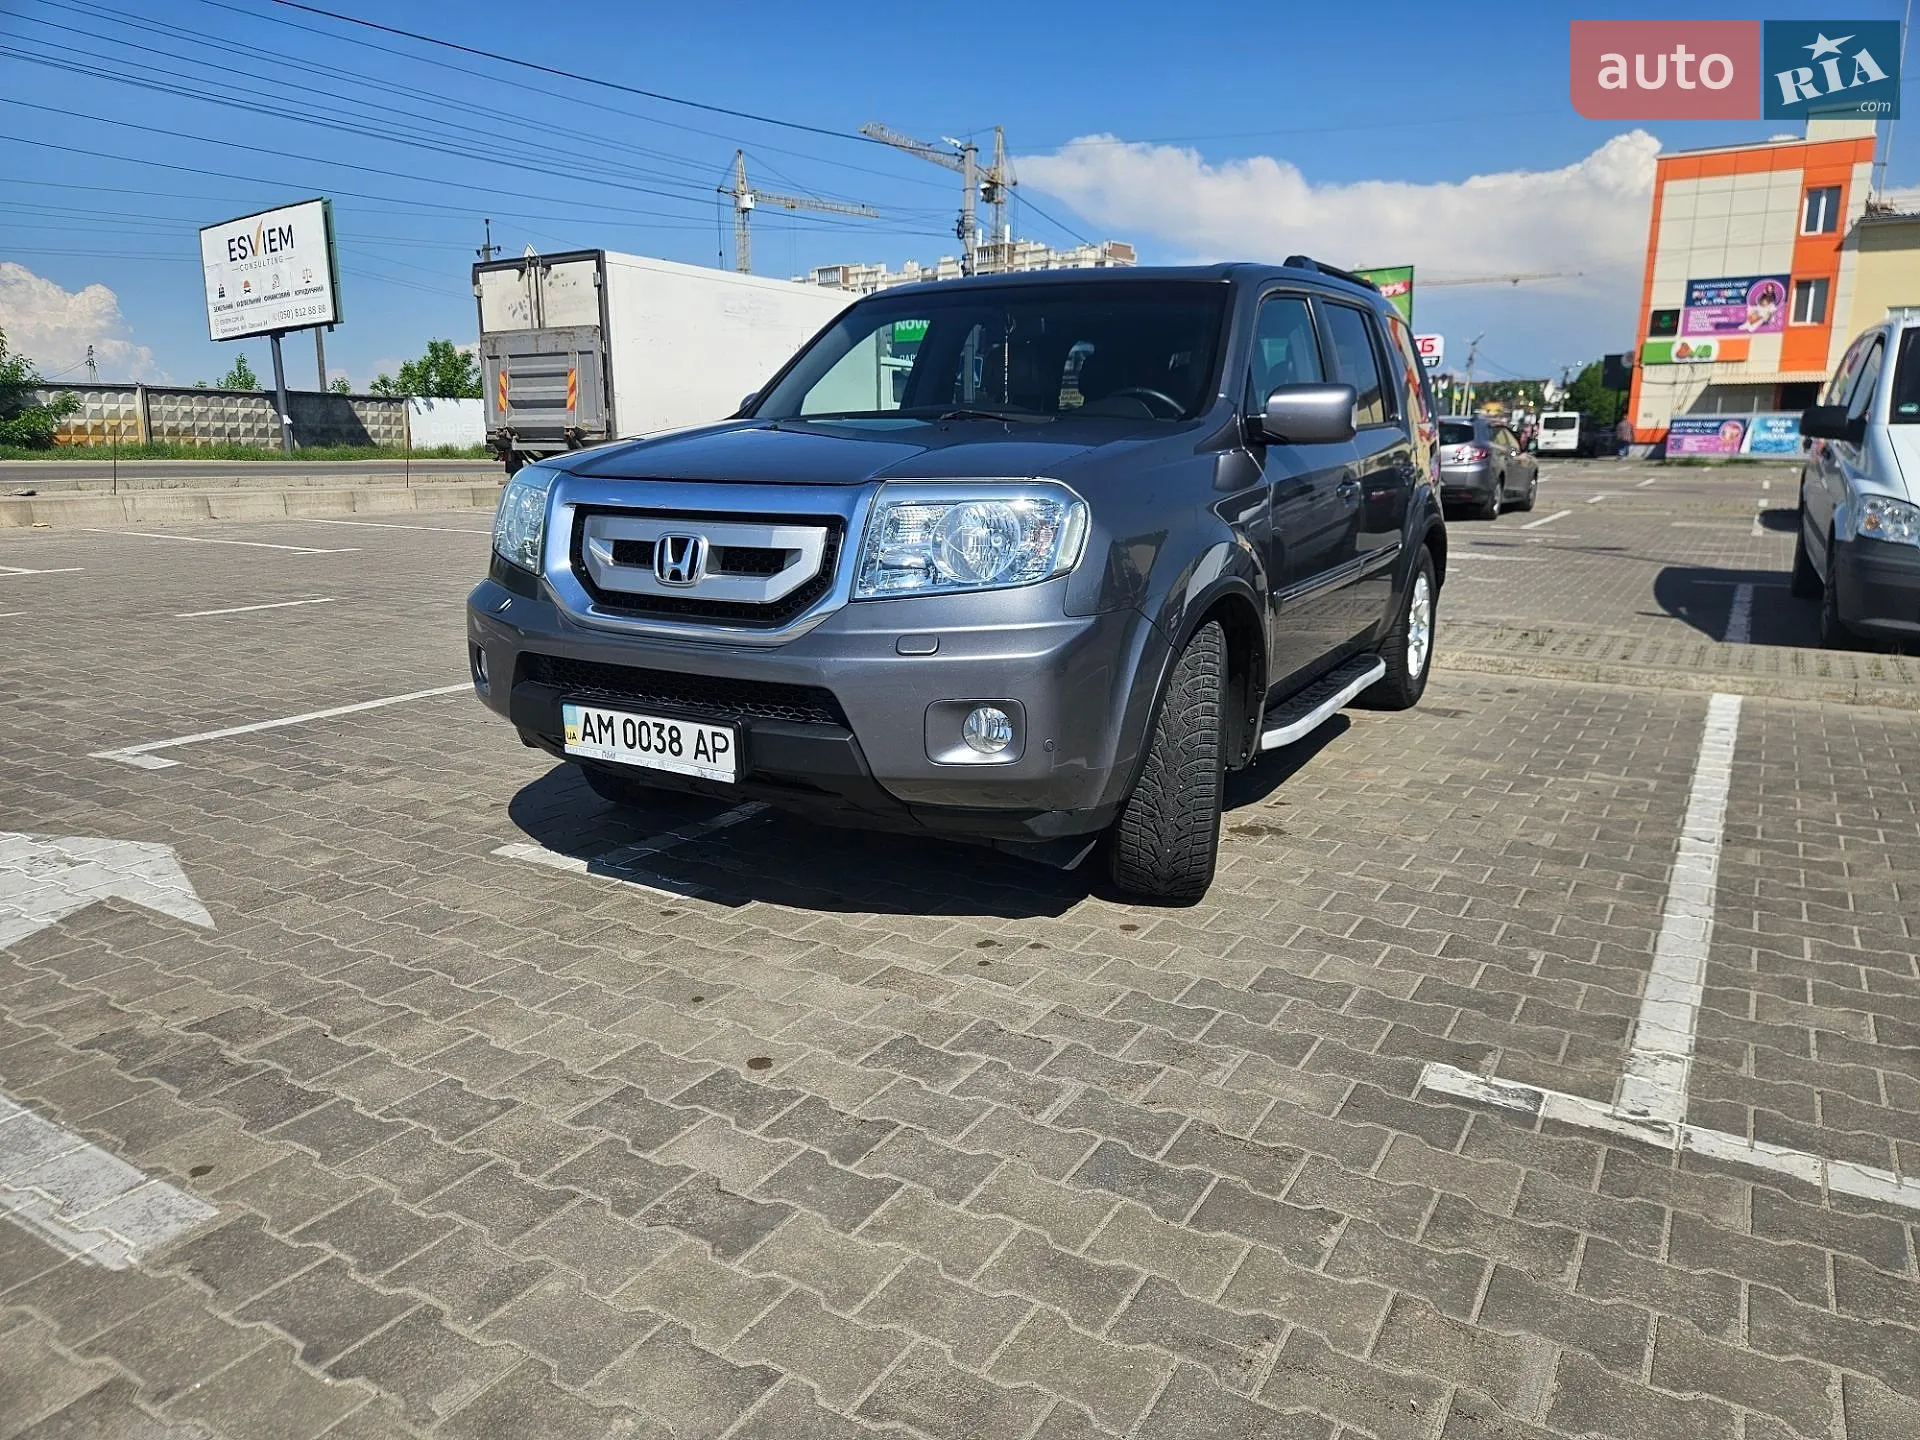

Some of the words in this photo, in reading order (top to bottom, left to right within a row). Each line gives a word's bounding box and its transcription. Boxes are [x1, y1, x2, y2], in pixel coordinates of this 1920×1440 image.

[227, 220, 294, 262] ESVIEM
[239, 255, 284, 272] CONSULTING
[566, 730, 578, 741] UA
[581, 711, 616, 747] AM
[622, 717, 684, 757] 0038
[693, 728, 730, 764] AP
